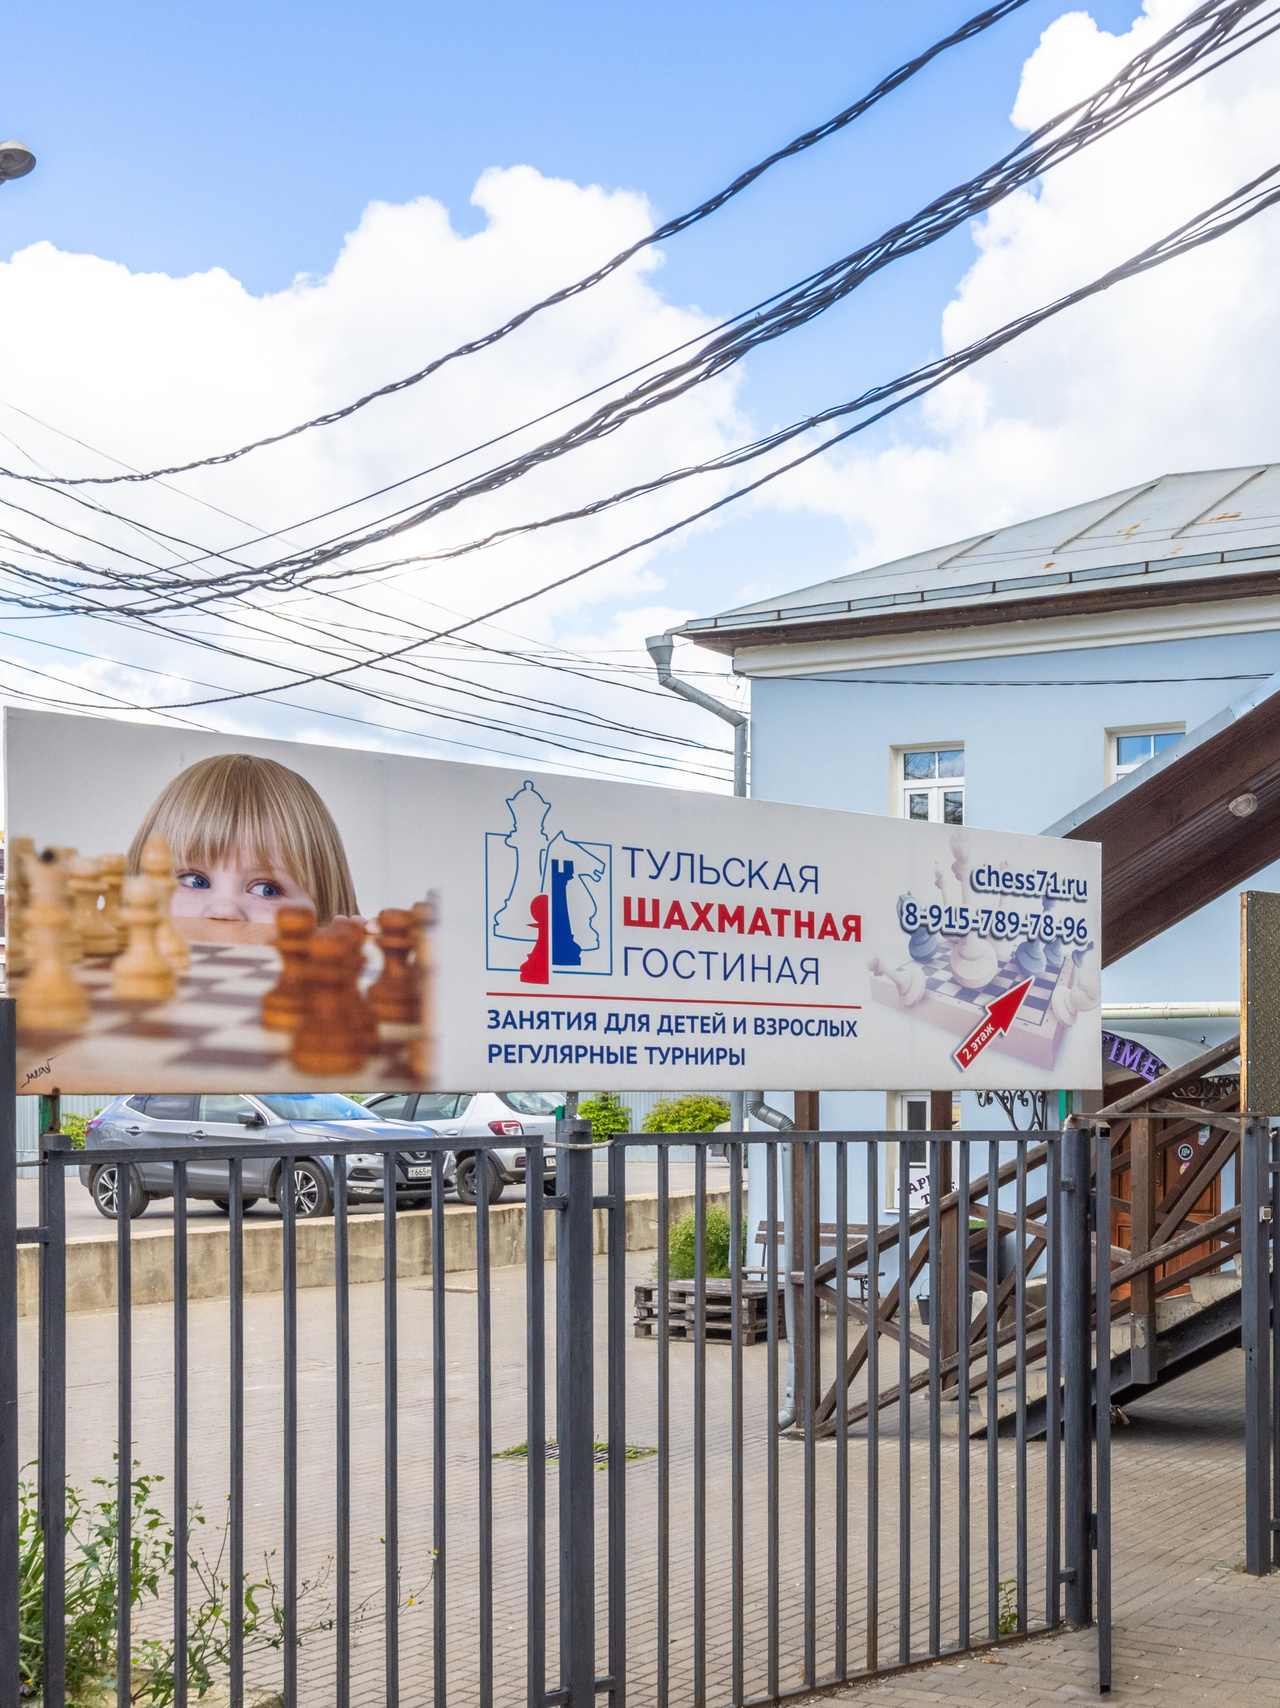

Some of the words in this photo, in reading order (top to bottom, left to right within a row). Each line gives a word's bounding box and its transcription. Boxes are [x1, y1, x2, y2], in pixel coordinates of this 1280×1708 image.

[621, 846, 819, 894] ТУЛЬСКАЯ
[975, 865, 1088, 896] chess71.ru
[623, 896, 862, 942] ШАХМАТНАЯ
[904, 902, 1088, 939] 8-915-789-78-96
[623, 946, 819, 985] ГОСТИНАЯ
[487, 1009, 597, 1031] ЗАНЯТИЯ
[603, 1013, 650, 1034] ДЛЯ
[656, 1012, 726, 1036] ДЕТЕЙ
[733, 1017, 747, 1034] И
[753, 1017, 858, 1037] ВЗРОСЛЫХ
[962, 1048, 972, 1060] 2
[970, 1023, 995, 1052] этаж
[488, 1044, 637, 1064] РЕГУЛЯРНЫЕ
[644, 1046, 745, 1066] ТУРНИРЫ
[411, 1167, 431, 1176] Т665Р
